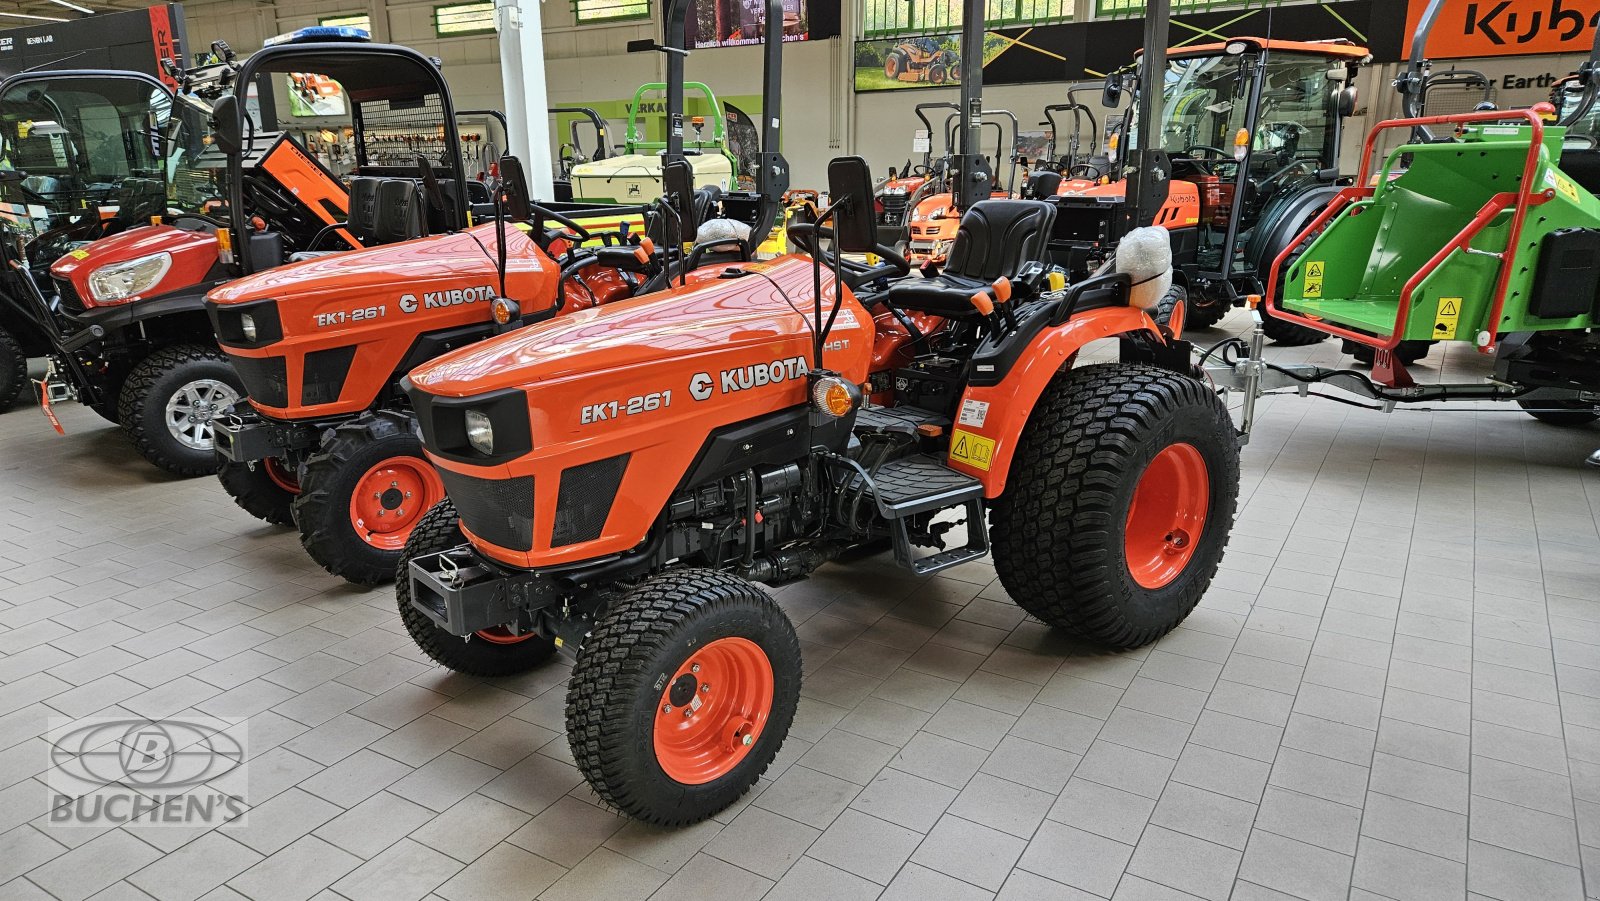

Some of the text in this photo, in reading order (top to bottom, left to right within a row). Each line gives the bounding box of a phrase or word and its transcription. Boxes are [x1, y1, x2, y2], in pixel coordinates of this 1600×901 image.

[0, 37, 13, 46] ER
[695, 40, 720, 49] Herzlich
[721, 36, 760, 47] willkommen
[781, 33, 805, 43] chen's
[1502, 73, 1556, 90] Earth
[625, 102, 667, 114] VRKA
[290, 146, 325, 180] DIESEL
[1170, 195, 1196, 203] Kubota
[423, 285, 496, 309] KUBOTA
[317, 305, 386, 327] EK1-261
[823, 339, 849, 352] HST
[719, 355, 809, 394] KUBOTA
[580, 389, 672, 425] EK1-261
